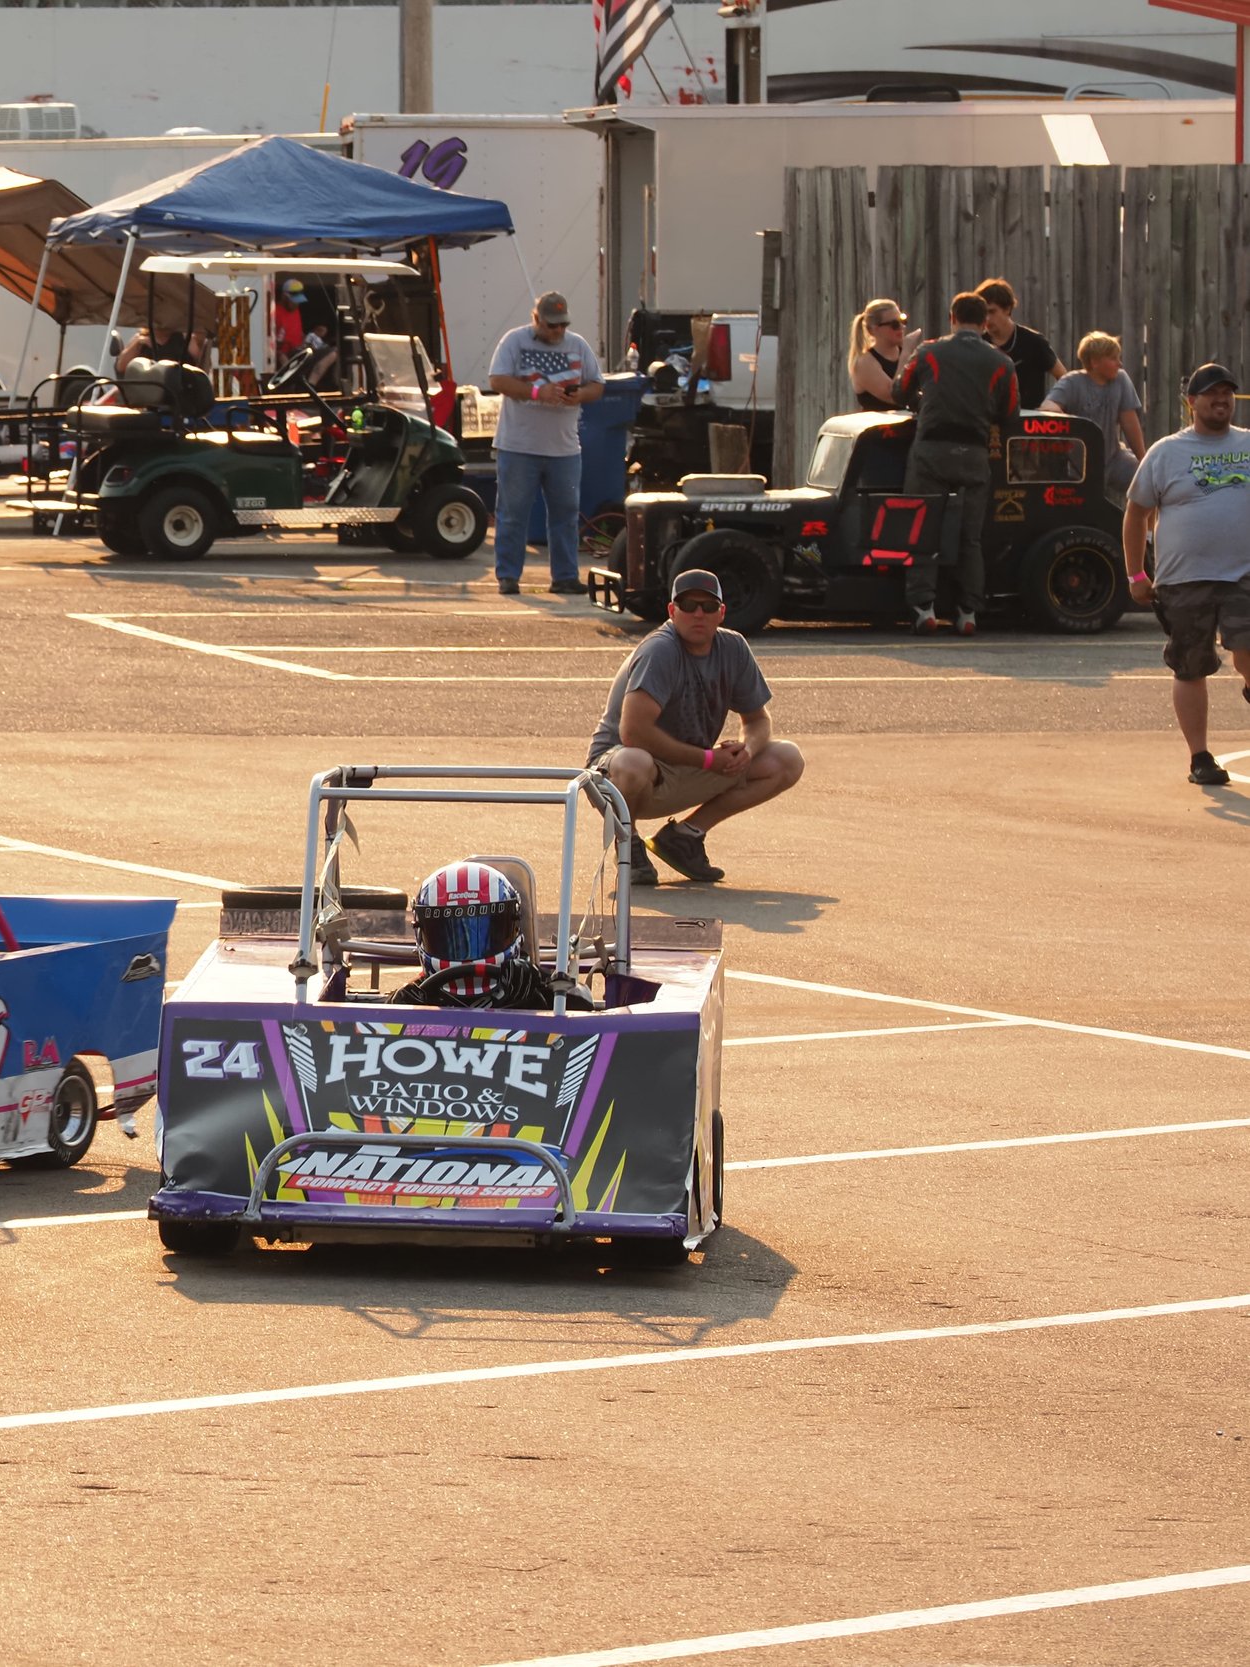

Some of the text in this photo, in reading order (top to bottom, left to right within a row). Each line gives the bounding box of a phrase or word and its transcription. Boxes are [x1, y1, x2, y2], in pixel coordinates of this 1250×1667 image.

[1023, 419, 1071, 434] UNOH
[700, 503, 792, 512] SPEED SHOP
[182, 1040, 263, 1079] 24
[325, 1034, 551, 1098] HOWE
[370, 1080, 503, 1104] PATIO &
[350, 1095, 519, 1122] WINDOWS
[295, 1175, 549, 1198] COMPACT TOURING SERIES
